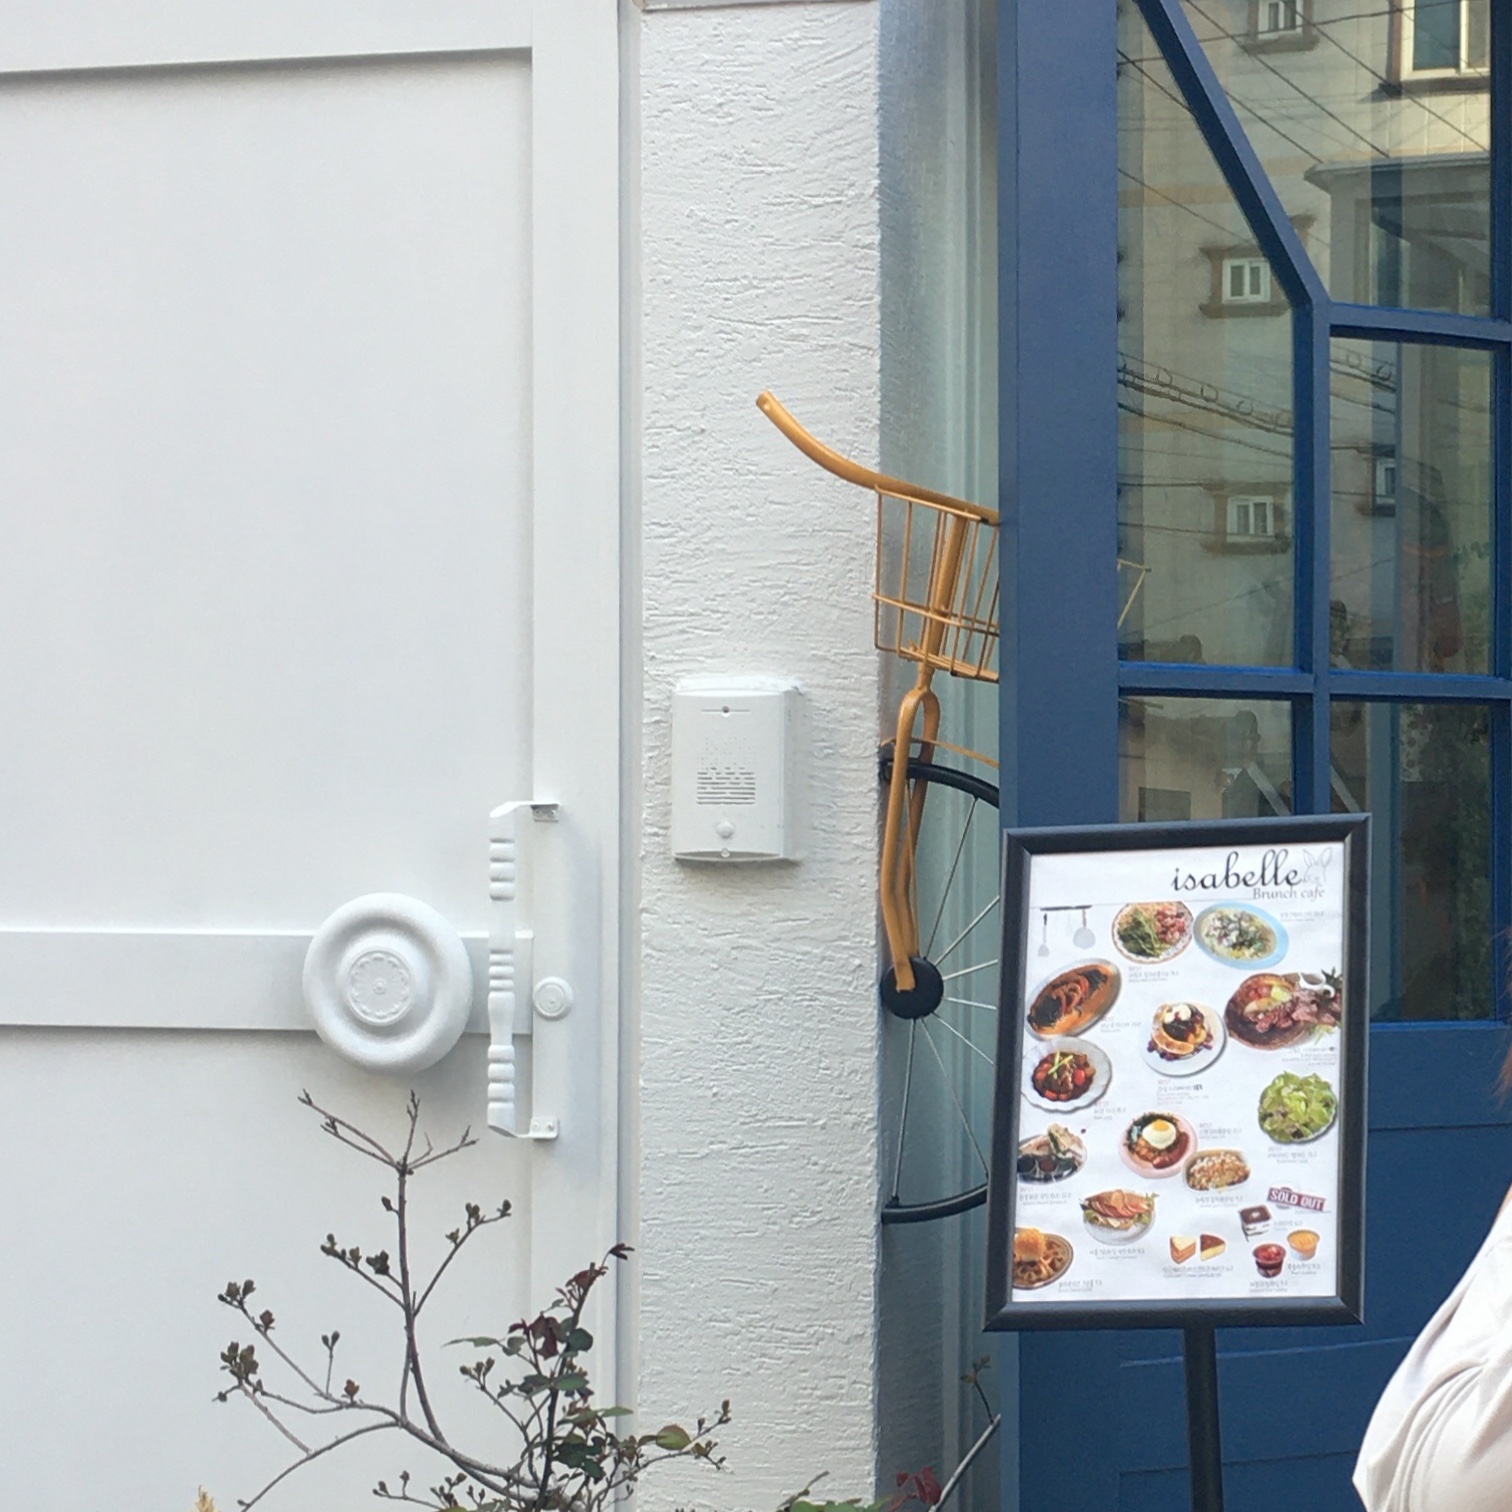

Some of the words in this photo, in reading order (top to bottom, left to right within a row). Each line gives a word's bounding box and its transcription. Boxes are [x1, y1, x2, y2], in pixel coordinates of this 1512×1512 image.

[1171, 848, 1301, 891] isabelle
[1252, 887, 1297, 901] Brunch
[1300, 884, 1326, 902] cafe
[1270, 1189, 1298, 1205] SOLD
[1300, 1196, 1324, 1210] OUT
